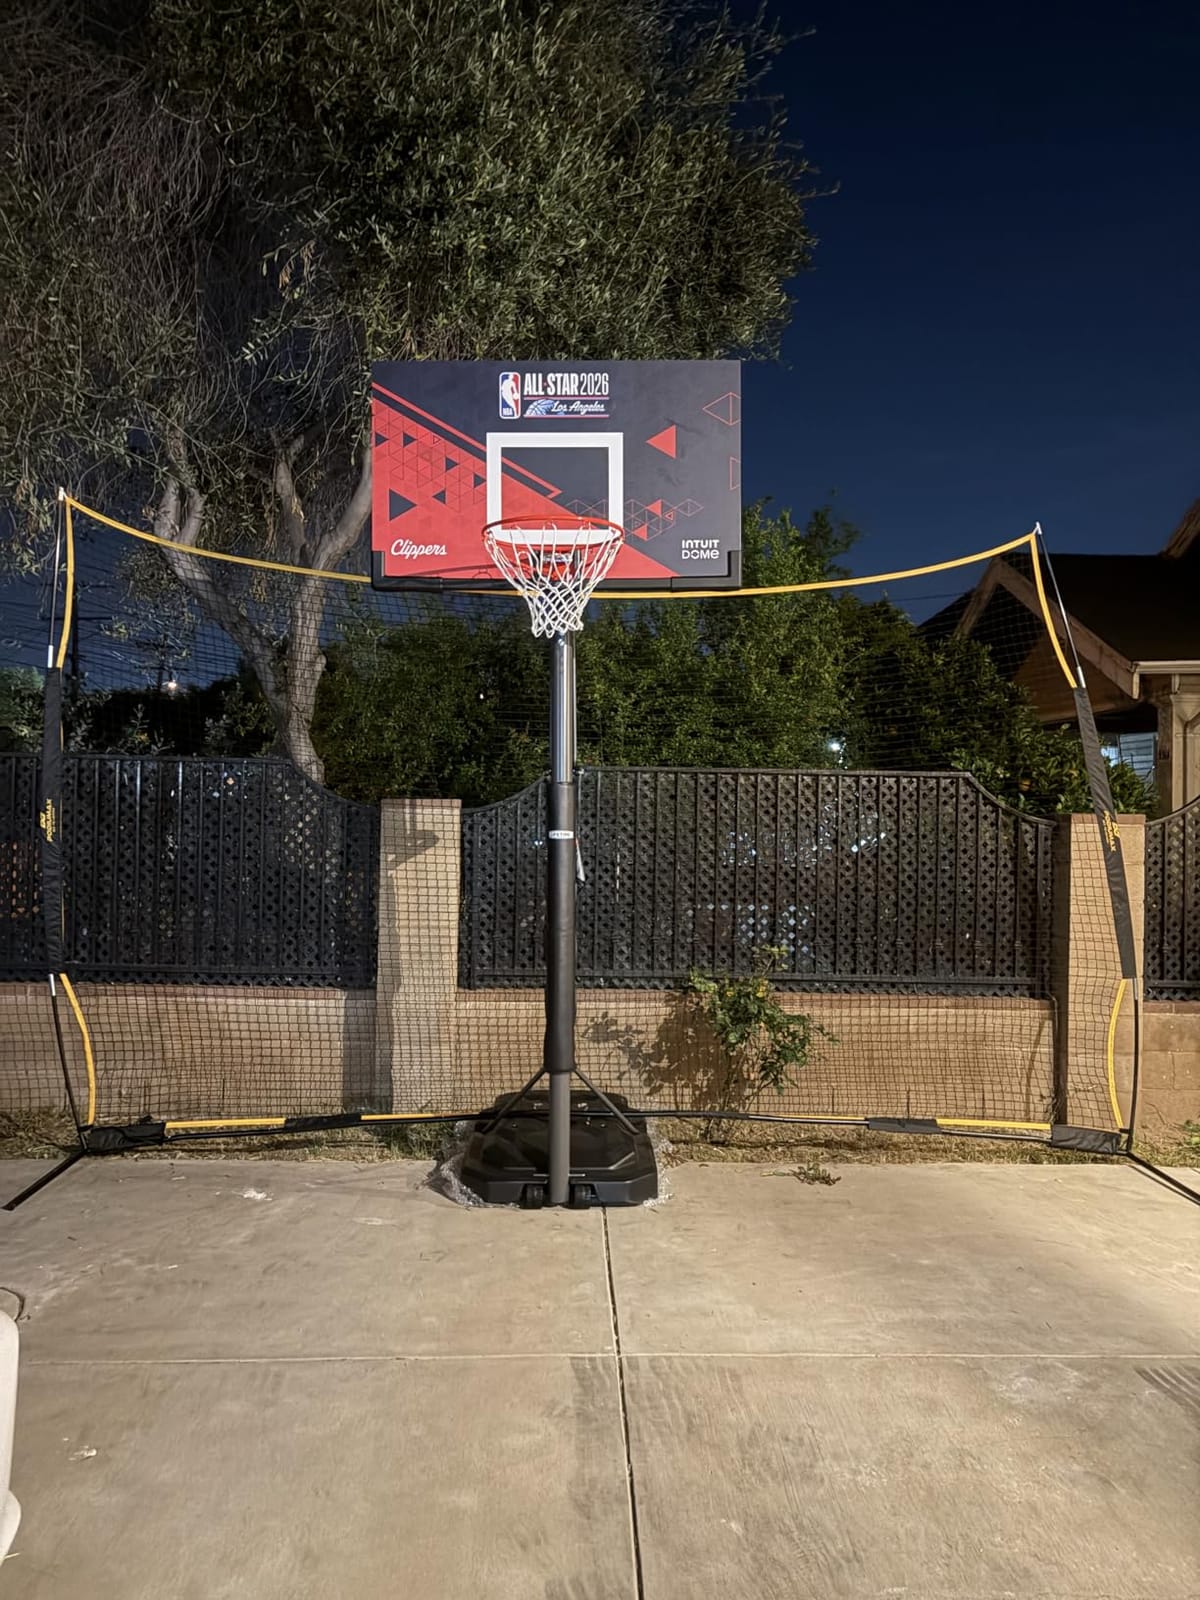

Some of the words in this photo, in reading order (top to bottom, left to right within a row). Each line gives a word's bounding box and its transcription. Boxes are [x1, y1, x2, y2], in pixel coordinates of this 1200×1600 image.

[580, 373, 609, 395] 2026
[551, 400, 567, 412] Los
[569, 400, 605, 415] Angeles
[391, 538, 448, 560] Clippers
[682, 539, 720, 549] INTUIT
[682, 549, 720, 560] DOME
